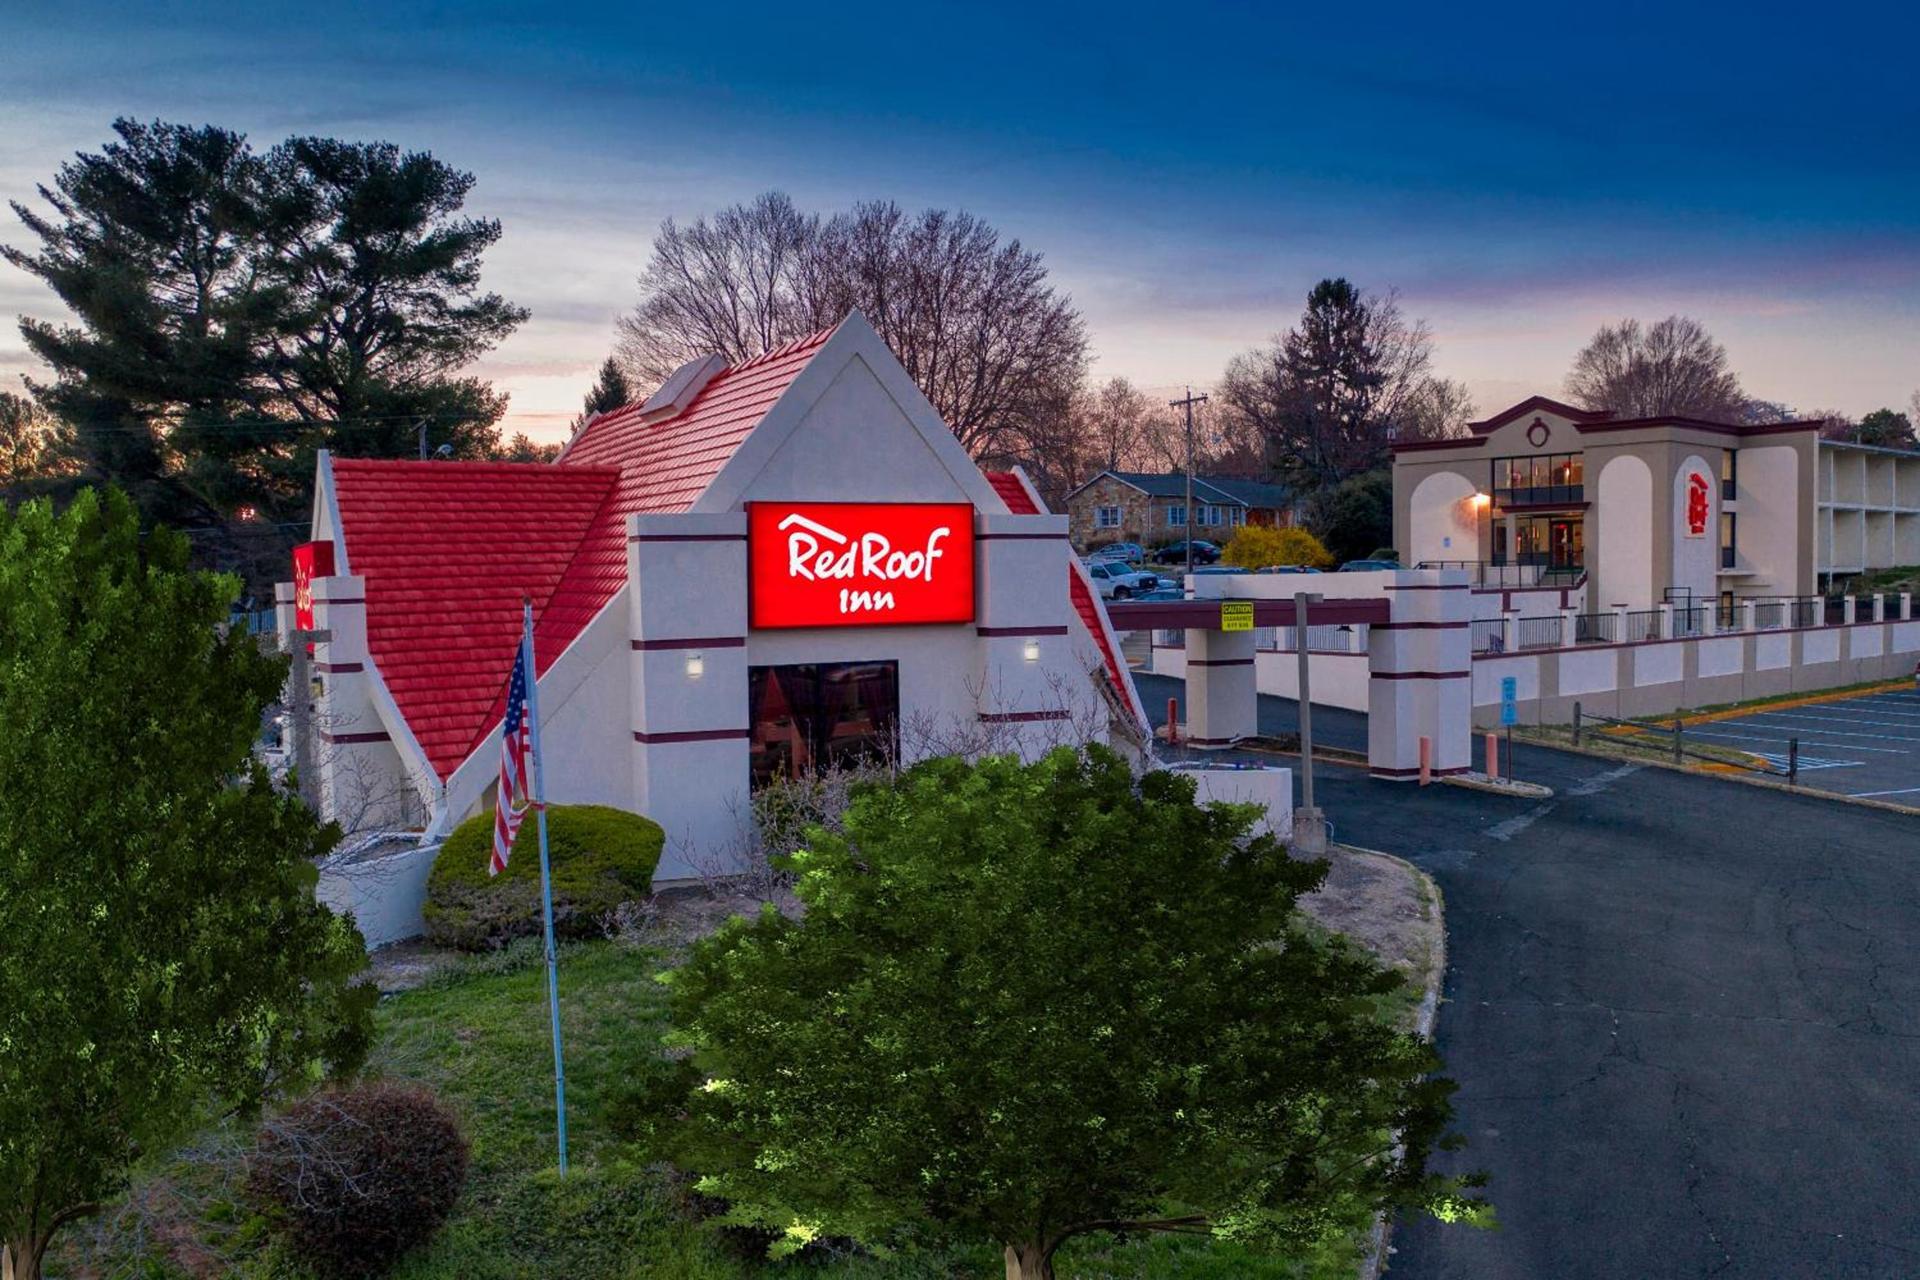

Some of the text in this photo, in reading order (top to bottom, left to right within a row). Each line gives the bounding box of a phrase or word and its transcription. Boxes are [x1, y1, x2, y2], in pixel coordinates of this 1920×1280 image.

[788, 527, 951, 582] Red Roof
[1223, 605, 1252, 614] CAUTION
